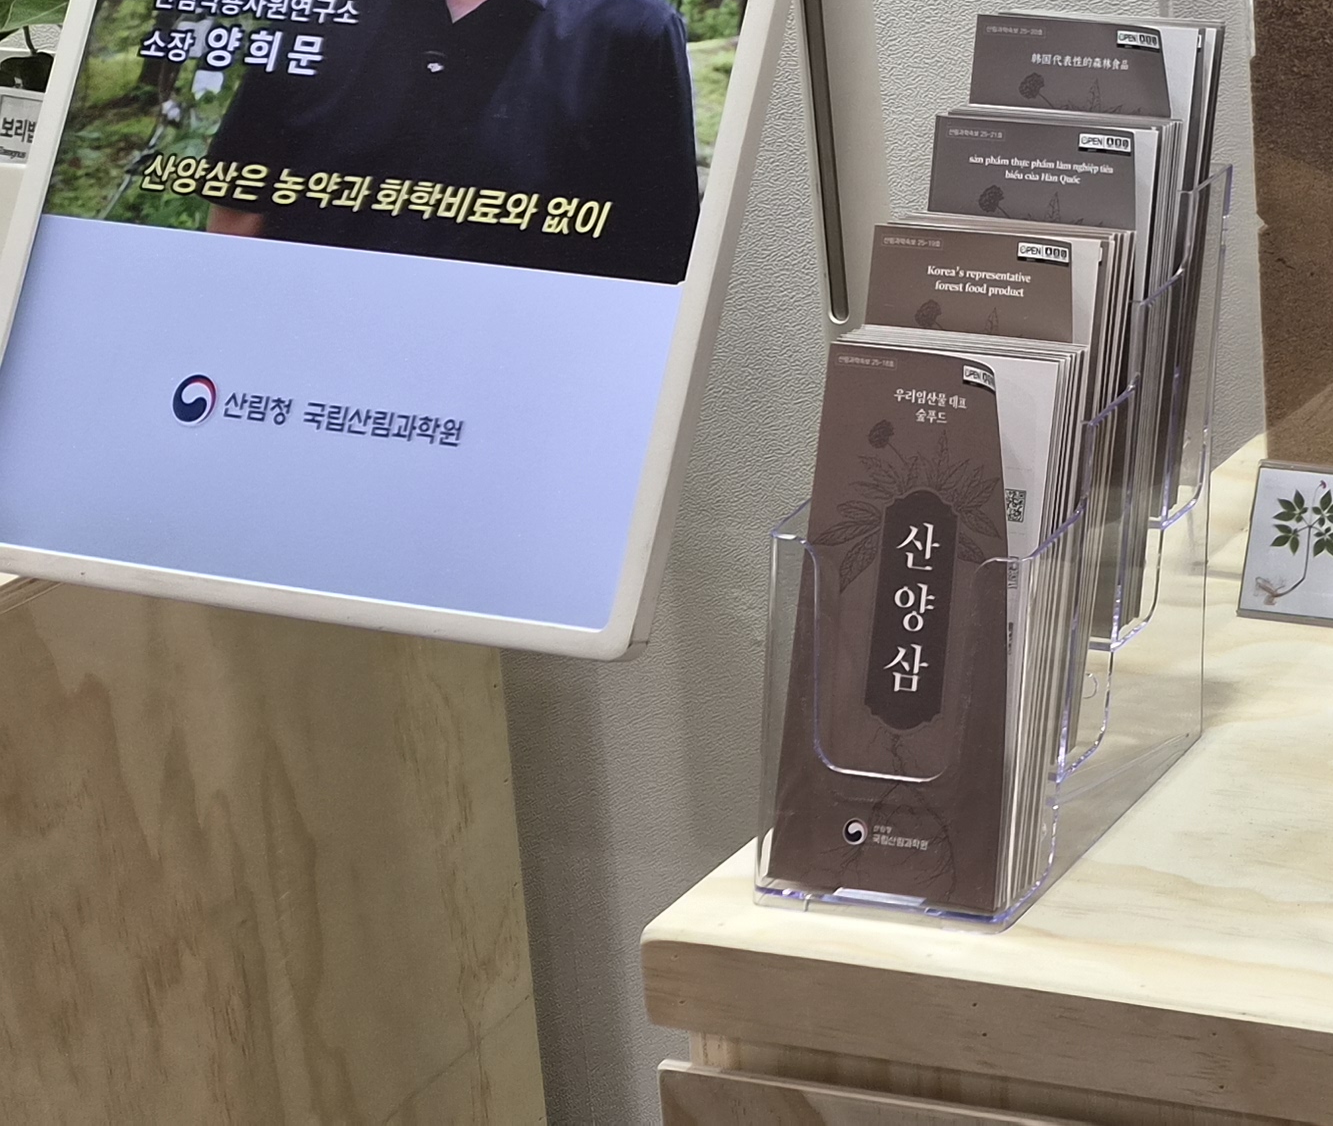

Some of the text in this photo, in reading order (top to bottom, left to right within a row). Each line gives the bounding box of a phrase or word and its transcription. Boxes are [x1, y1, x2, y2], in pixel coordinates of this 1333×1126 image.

[139, 29, 195, 61] 소장
[1031, 52, 1130, 71] 韩国代表性的森林食品
[139, 153, 613, 239] 산양삼은 농약과 화학비료와 없이
[927, 265, 1032, 284] Korea's representative
[935, 280, 1025, 298] forest food product
[894, 388, 968, 409] 우리임산물 대표
[223, 391, 465, 448] 산림청 국립산림과학원
[915, 408, 948, 423] 숲푸드
[884, 521, 940, 693] 산양삼
